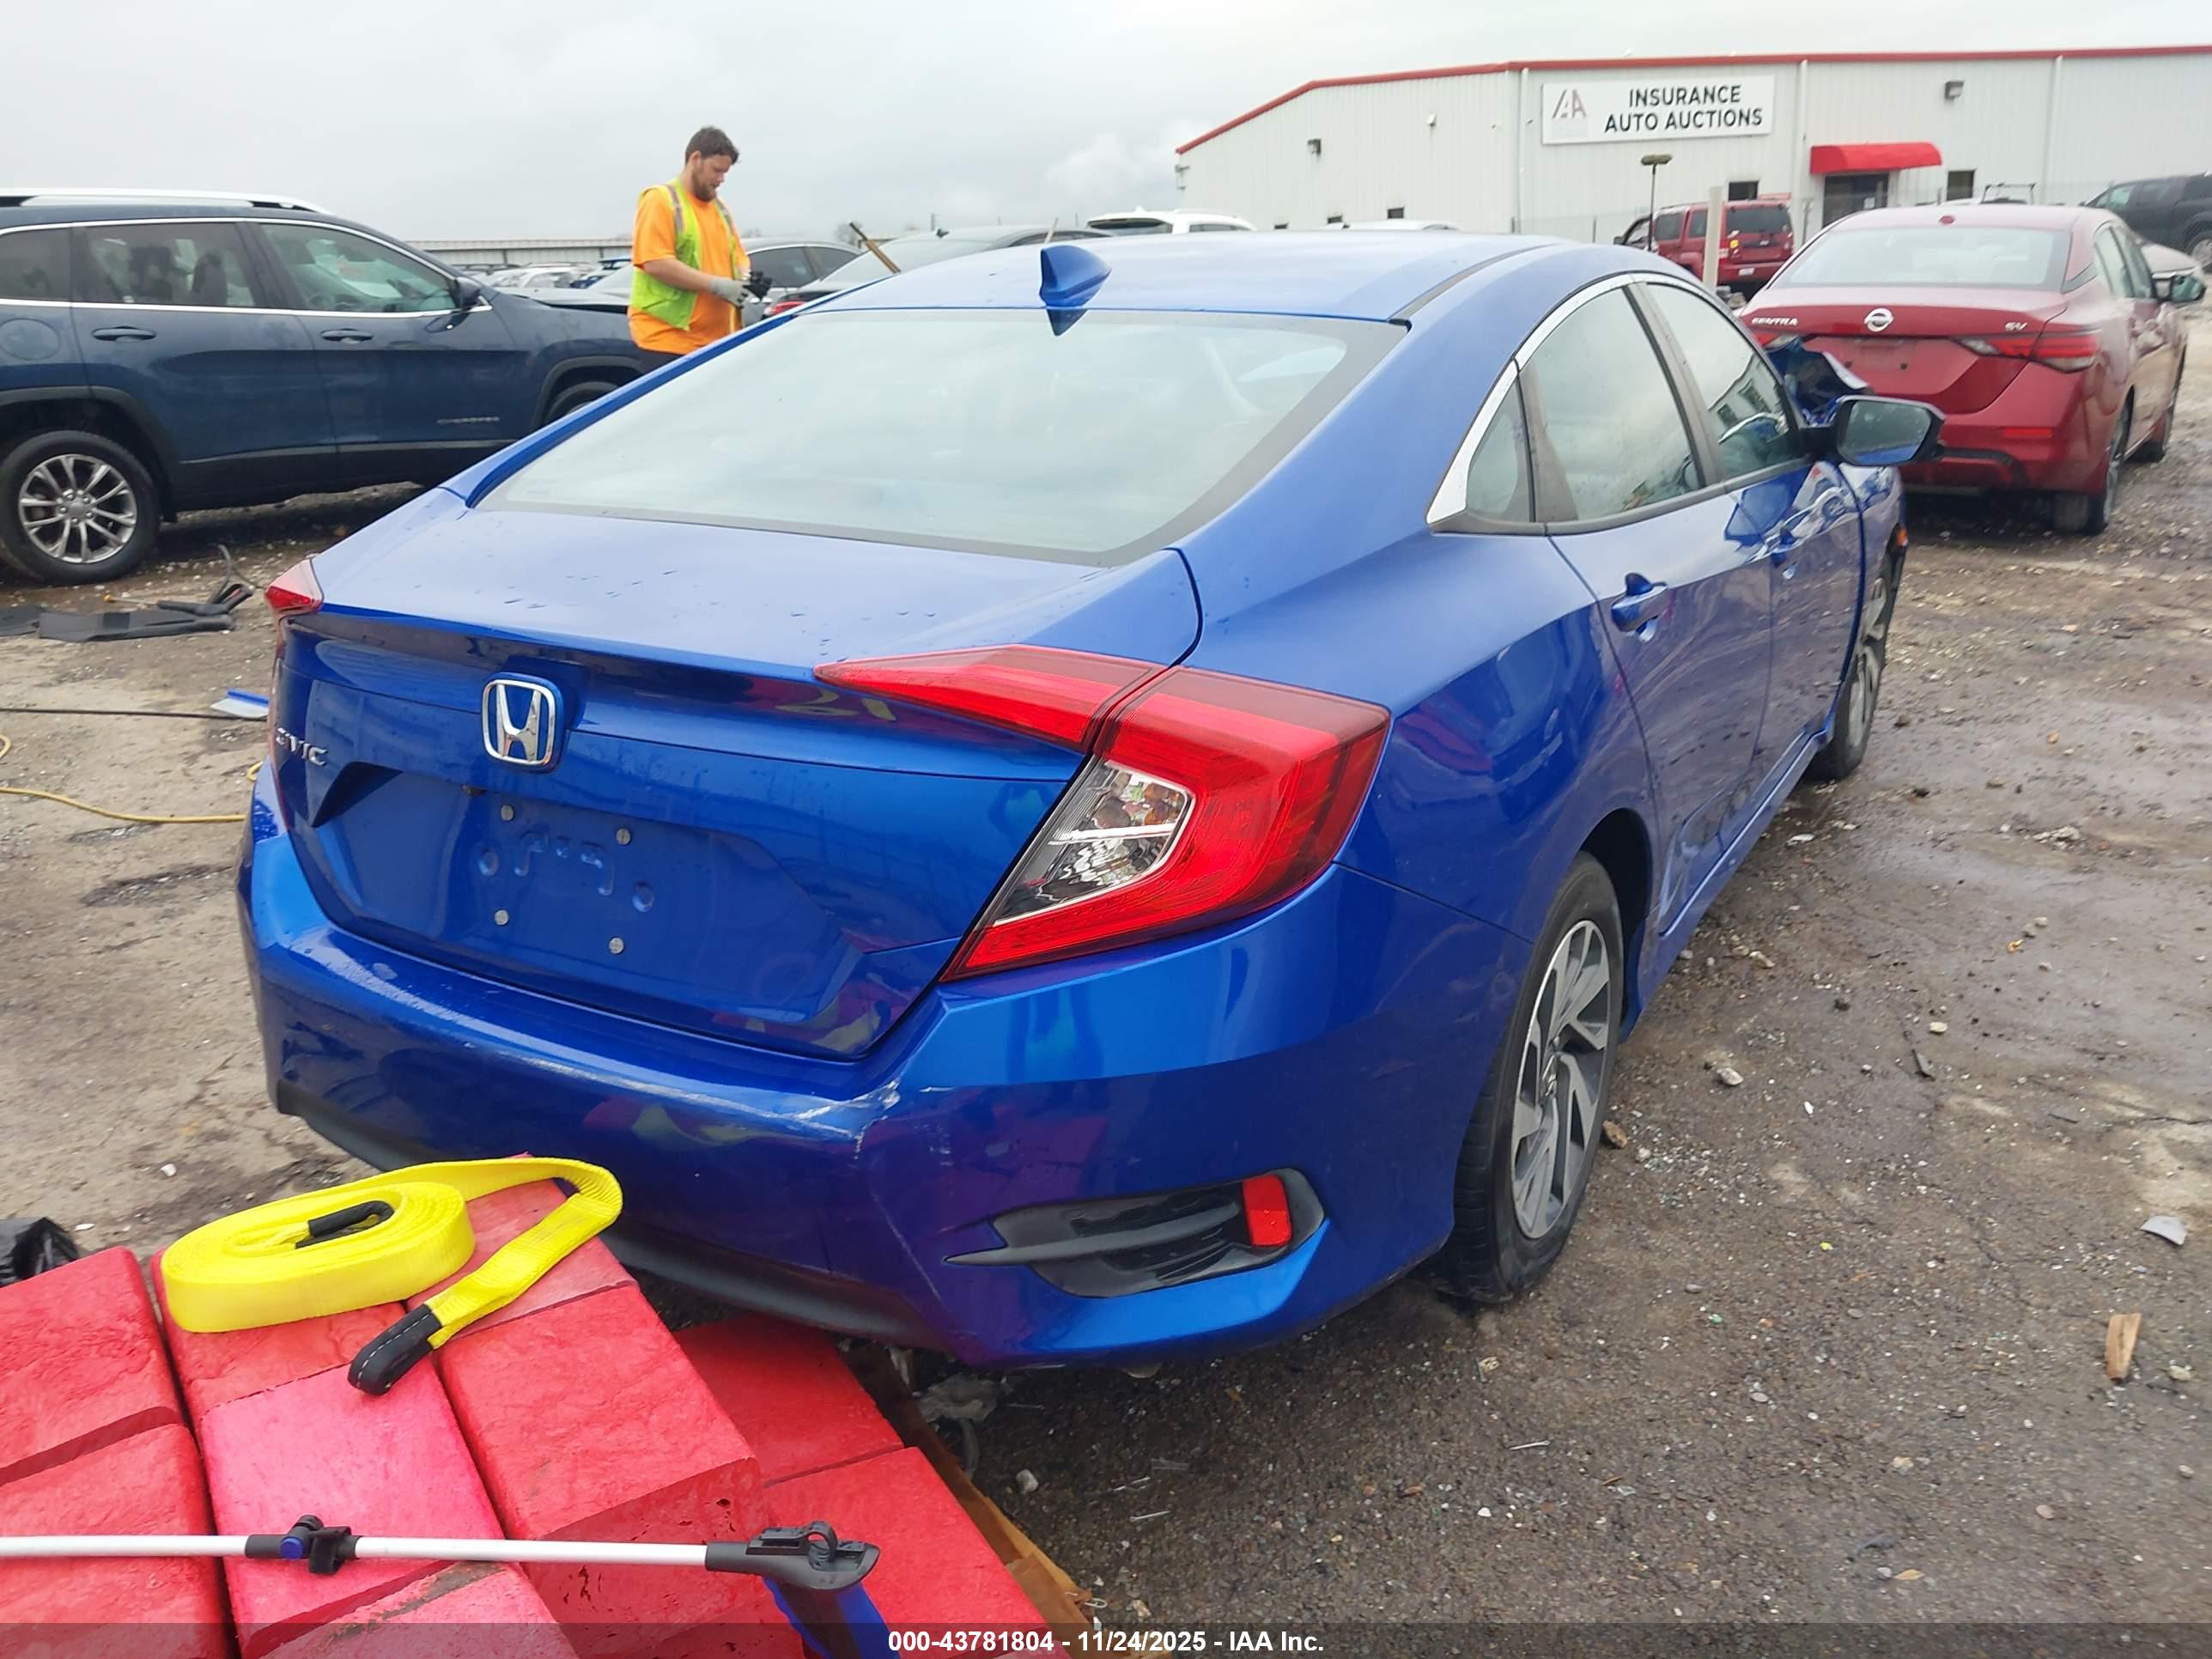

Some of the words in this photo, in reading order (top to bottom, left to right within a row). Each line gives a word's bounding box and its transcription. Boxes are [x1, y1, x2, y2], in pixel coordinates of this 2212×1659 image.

[1629, 84, 1741, 107] INSURANCE
[1604, 112, 1659, 132] AUTO
[1664, 108, 1763, 131] AUCTIONS
